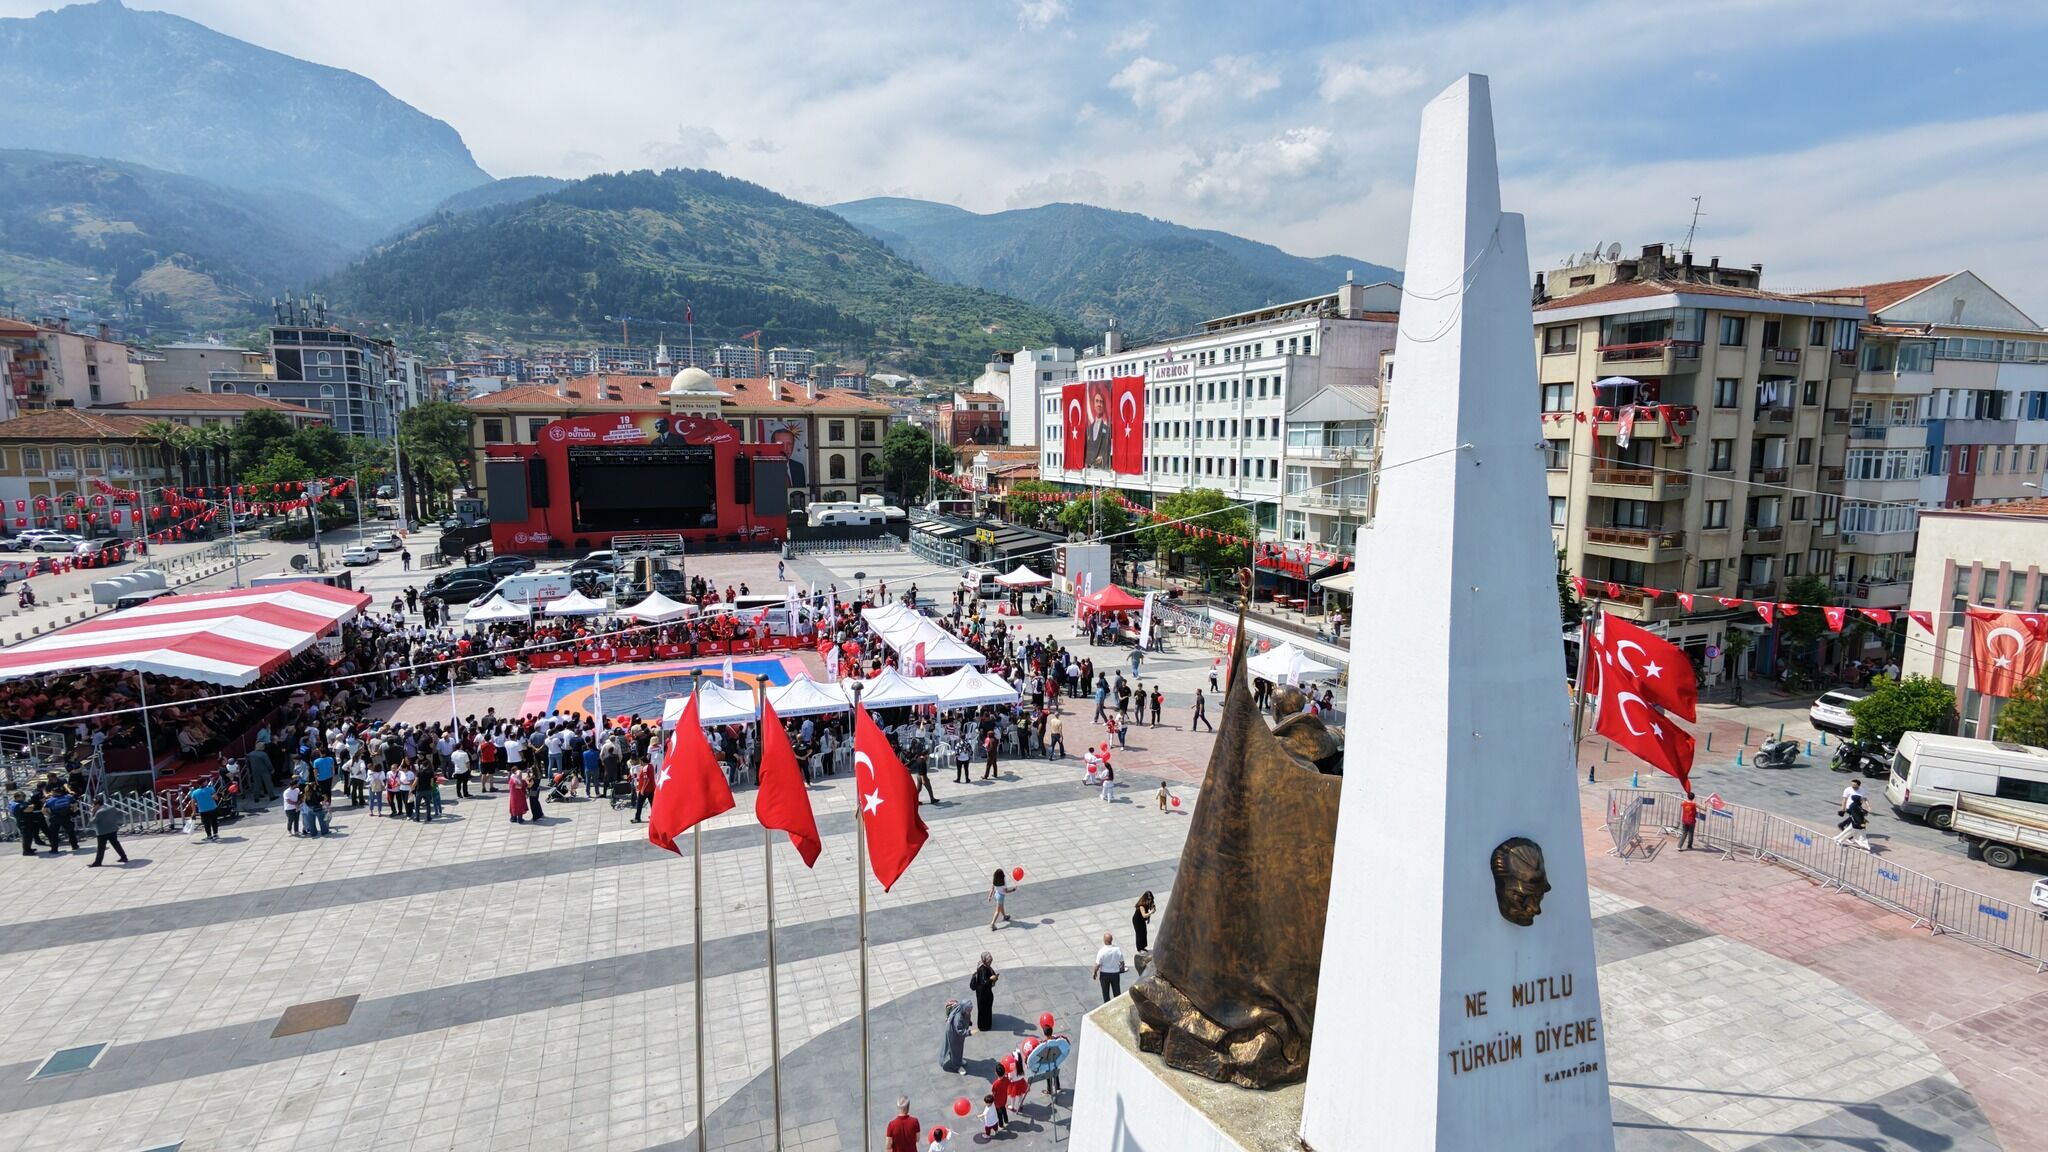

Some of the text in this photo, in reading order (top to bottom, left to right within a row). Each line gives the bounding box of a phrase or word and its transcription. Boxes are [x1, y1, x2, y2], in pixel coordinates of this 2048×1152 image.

[1155, 364, 1189, 379] ANEMON
[620, 415, 630, 424] 19
[1465, 973, 1573, 1018] NE MUTLU
[1448, 1018, 1597, 1075] TÜRKÜM DİYENE
